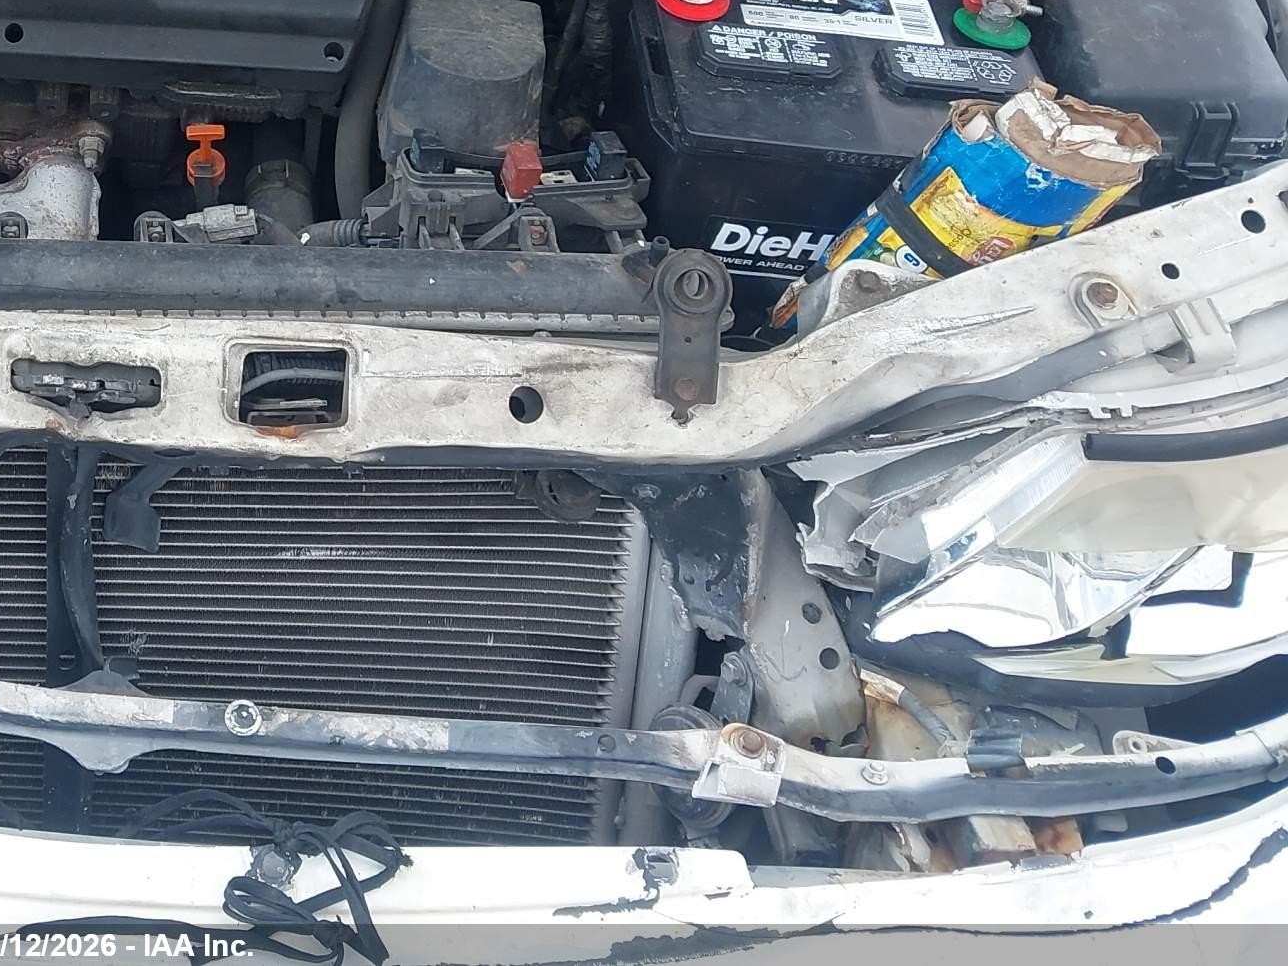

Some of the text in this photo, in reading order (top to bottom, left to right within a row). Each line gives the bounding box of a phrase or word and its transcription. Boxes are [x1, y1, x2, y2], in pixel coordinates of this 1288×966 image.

[854, 15, 893, 25] SILVER
[722, 25, 767, 37] DANGER
[776, 31, 817, 41] POISON
[710, 222, 836, 262] DieH
[947, 227, 972, 249] Class
[755, 260, 805, 272] AHEAD
